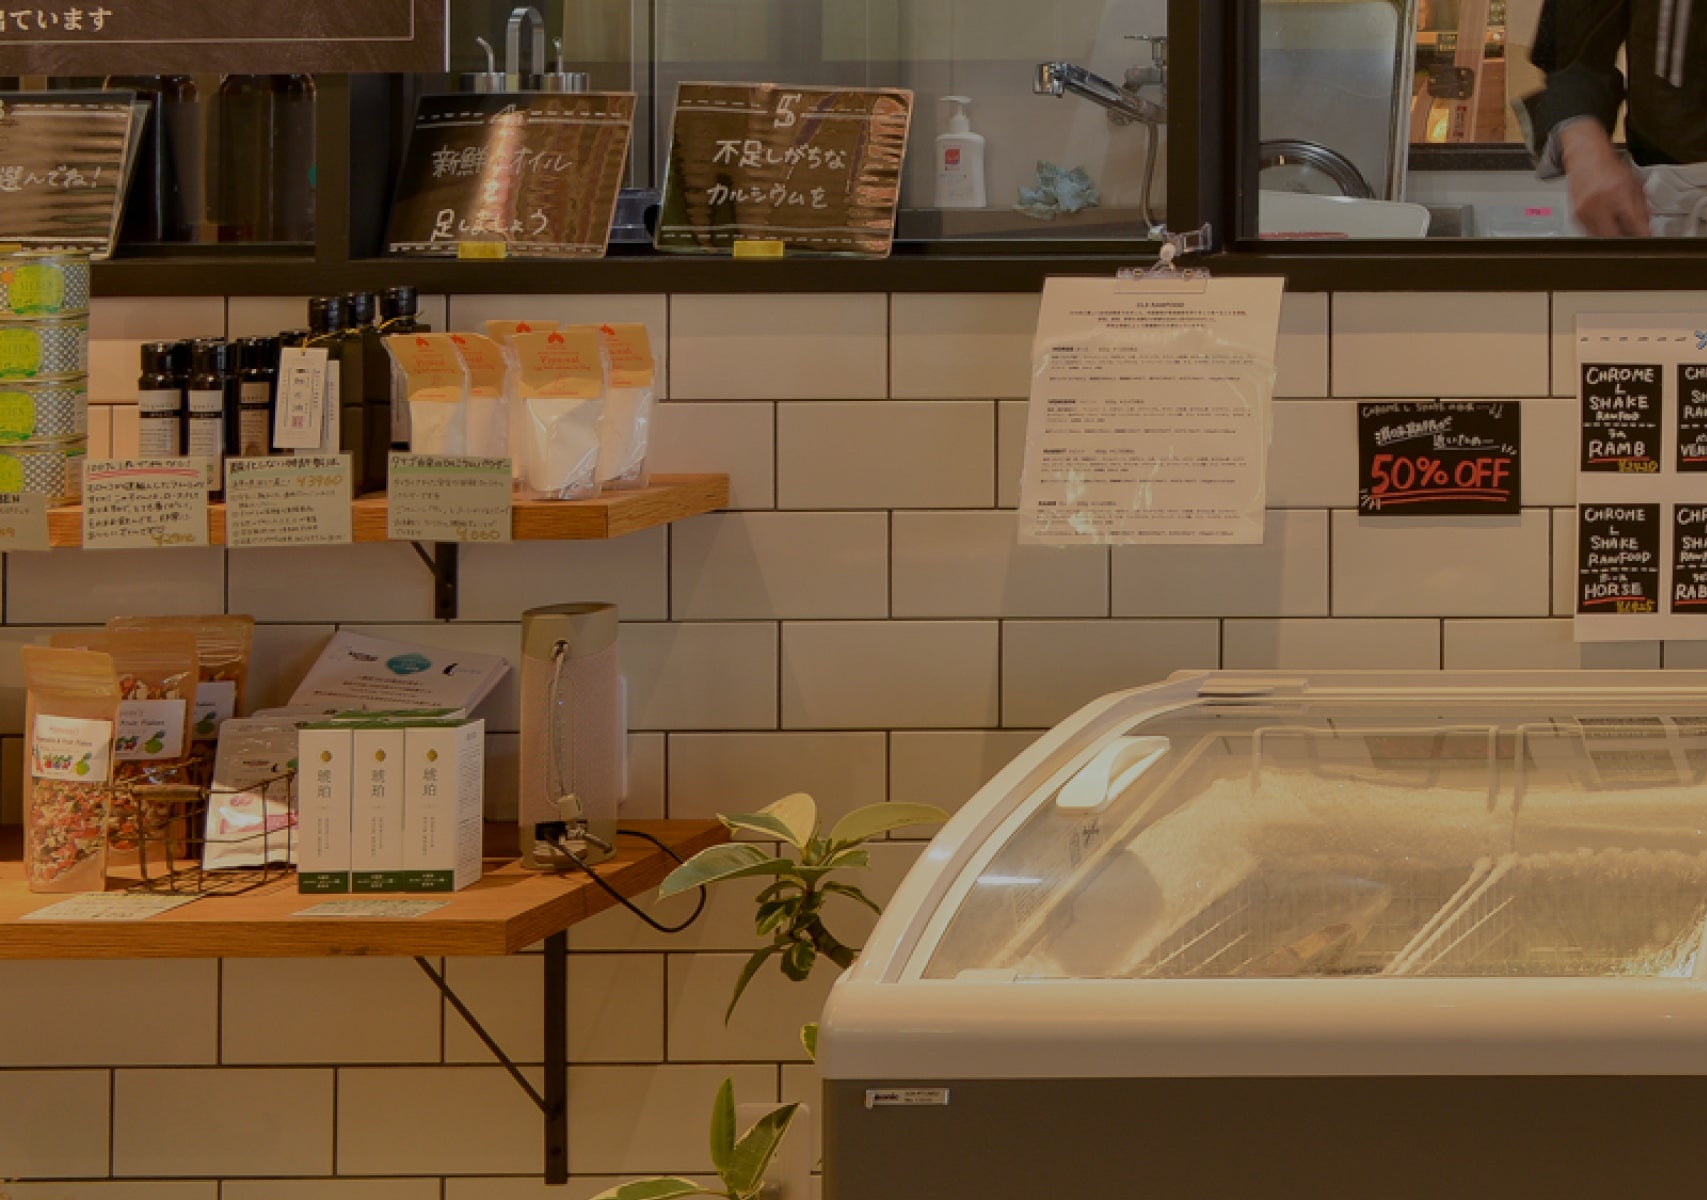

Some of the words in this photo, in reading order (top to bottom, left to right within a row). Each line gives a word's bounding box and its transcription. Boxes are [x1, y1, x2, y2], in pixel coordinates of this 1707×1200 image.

[0, 7, 112, 32] ています
[773, 94, 801, 128] 5
[431, 144, 573, 178] 新鮮オイル
[713, 139, 847, 172] 不足しがちな
[1586, 366, 1654, 384] CHROME
[1615, 384, 1626, 394] L
[1589, 395, 1649, 410] SHAKE
[1371, 453, 1450, 493] 50%
[1455, 457, 1512, 489] OFF
[1585, 507, 1646, 521] CHROME
[1608, 525, 1620, 536] L
[1590, 536, 1639, 550] SHAKE
[1584, 583, 1643, 599] HORSE
